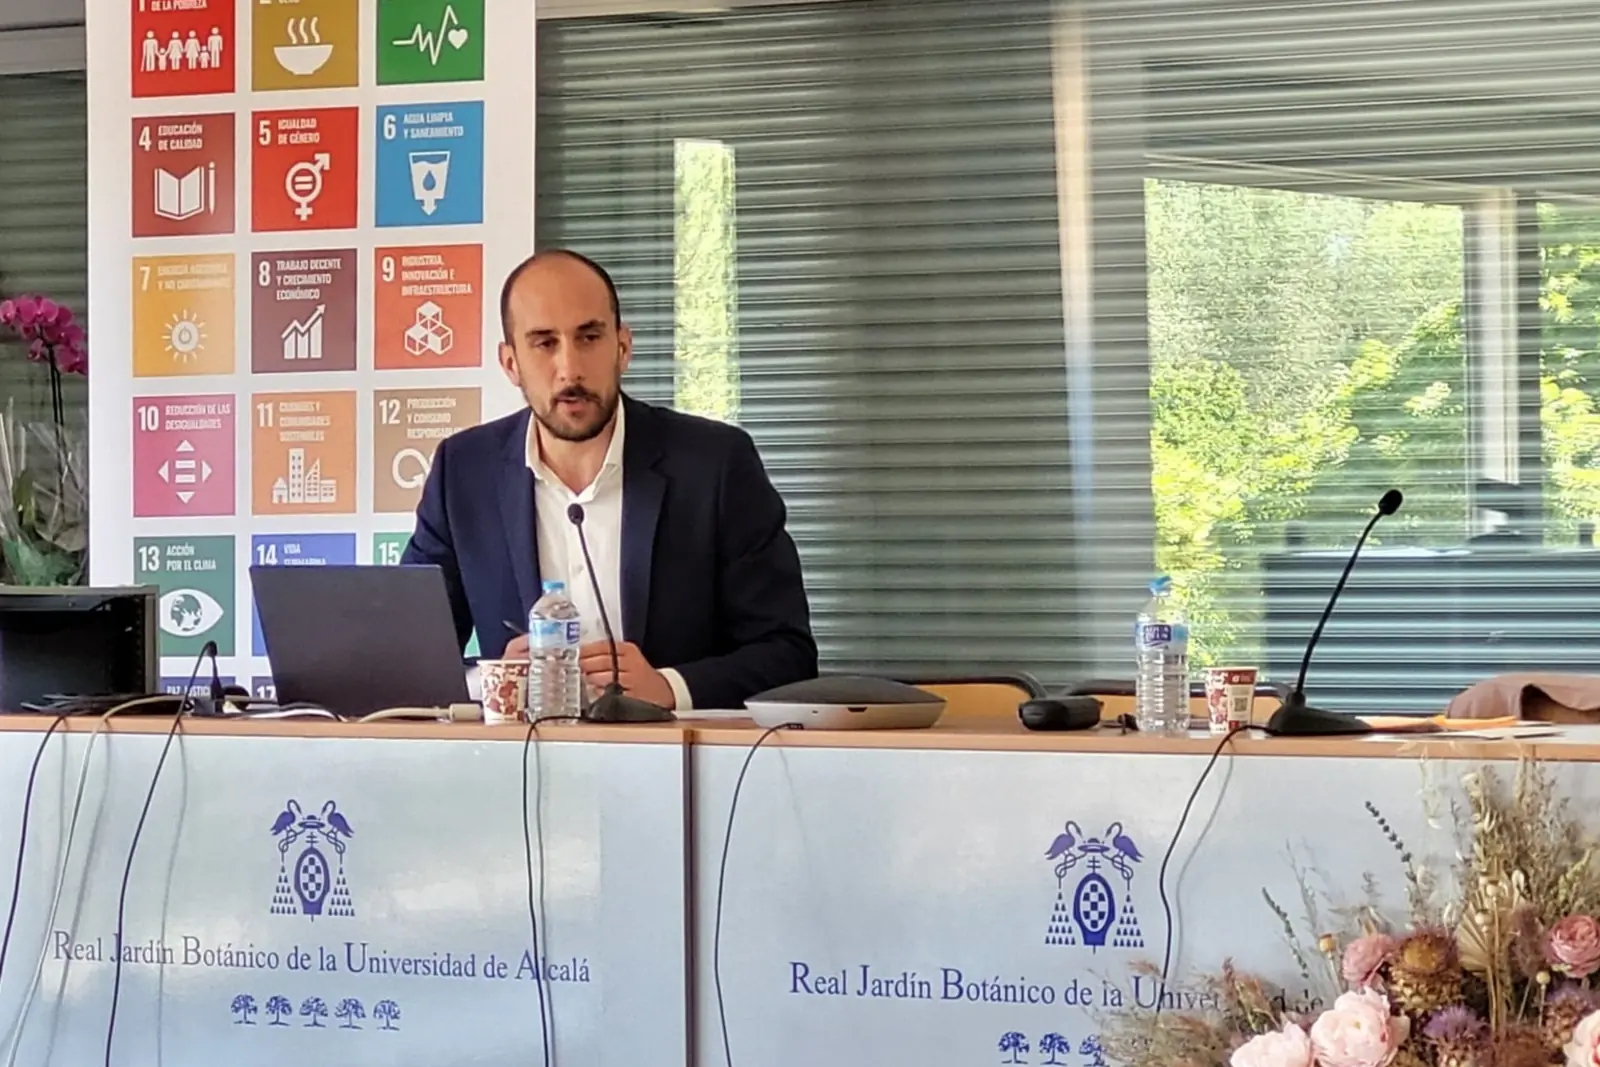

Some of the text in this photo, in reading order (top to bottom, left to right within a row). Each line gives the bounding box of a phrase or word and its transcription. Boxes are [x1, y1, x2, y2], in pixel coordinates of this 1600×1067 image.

[158, 121, 203, 136] EDUCACIÓN
[278, 118, 317, 130] IGUALDAD
[384, 114, 396, 139] 6
[403, 113, 425, 124] AGUA
[139, 126, 151, 152] 4
[158, 138, 203, 151] DE CALIDAD
[259, 120, 271, 146] 5
[278, 131, 320, 145] DE GÉNERO
[403, 128, 409, 139] Y
[258, 261, 271, 286] 8
[276, 258, 342, 271] TRABAJO DECENTE
[382, 256, 395, 282] 9
[139, 266, 150, 291] 7
[276, 273, 332, 286] Y CRECIMIENTO
[137, 405, 159, 431] 10
[208, 404, 217, 414] DE
[218, 403, 231, 414] LAS
[256, 402, 273, 428] 11
[379, 399, 401, 424] 12
[139, 545, 160, 571] 13
[167, 542, 195, 556] ACCIÓN
[256, 543, 278, 565] 14
[378, 541, 401, 565] 15
[166, 558, 217, 571] POR EL CLIMA
[257, 685, 276, 699] 17
[53, 930, 591, 983] Real Jardín Botánico de la Universidad de Alcalá
[789, 961, 848, 996] Real
[856, 964, 933, 1000] Jardín
[940, 967, 1056, 1005] Botánico
[1064, 979, 1092, 1006] de
[1102, 979, 1123, 1007] la
